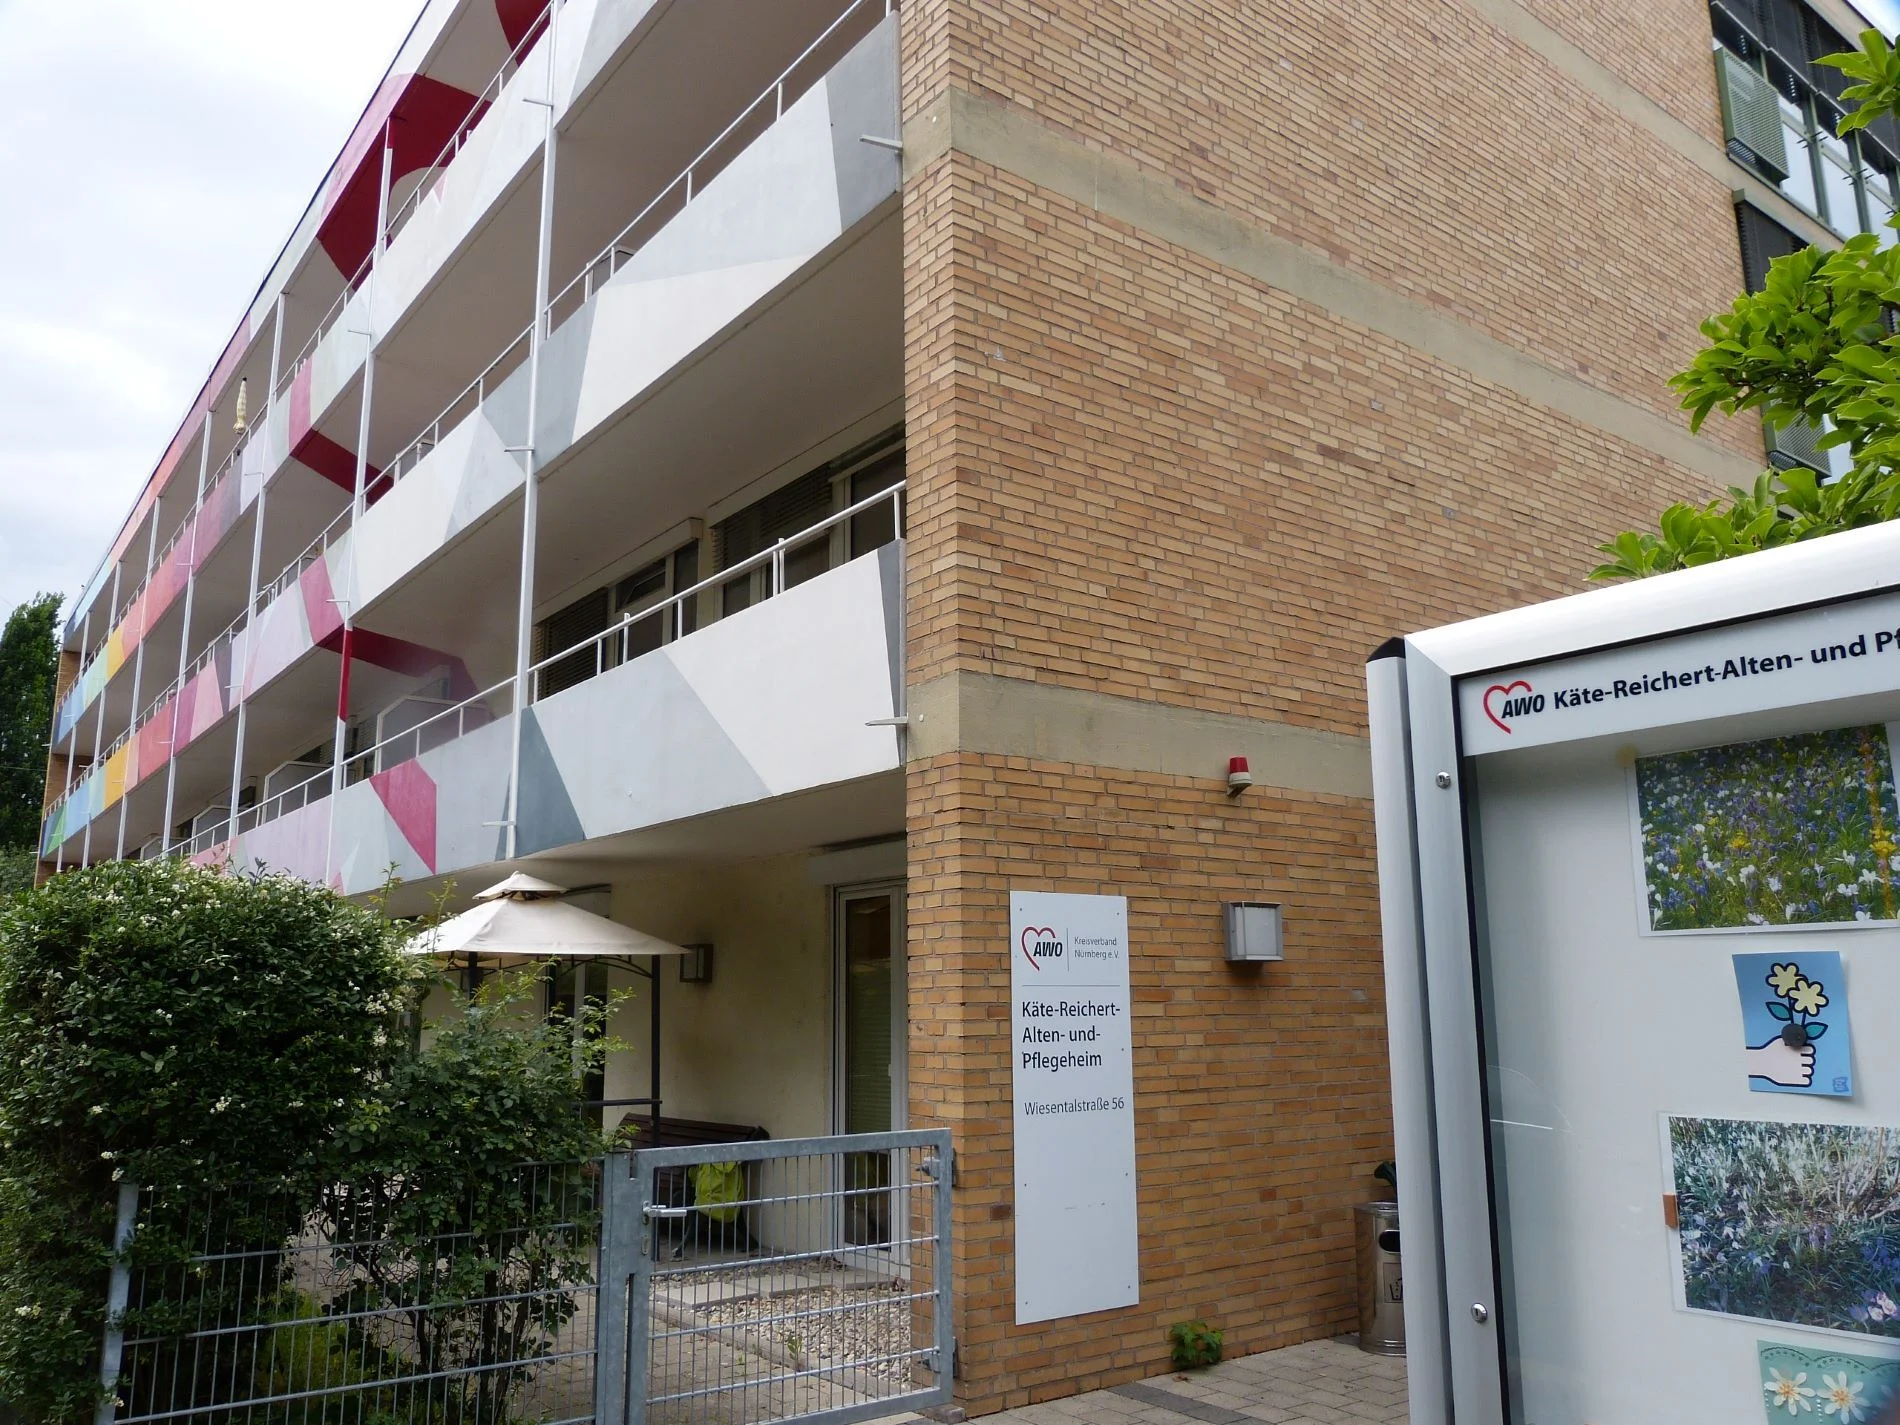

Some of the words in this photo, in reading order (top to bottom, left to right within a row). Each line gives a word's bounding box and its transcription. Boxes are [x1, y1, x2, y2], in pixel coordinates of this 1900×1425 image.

[1501, 694, 1545, 719] AWO
[1554, 655, 1803, 709] Käte-Reichert-Alten-
[1810, 634, 1867, 664] und
[1033, 941, 1063, 957] AWO
[1074, 936, 1117, 946] Kreisverband
[1022, 1001, 1121, 1017] Käte-Reichert-
[1022, 1026, 1066, 1043] Alten-
[1069, 1025, 1101, 1042] und-
[1022, 1051, 1102, 1072] Pflegeheim
[1024, 1097, 1110, 1115] Wiesentalstraße
[1112, 1097, 1125, 1110] 56
